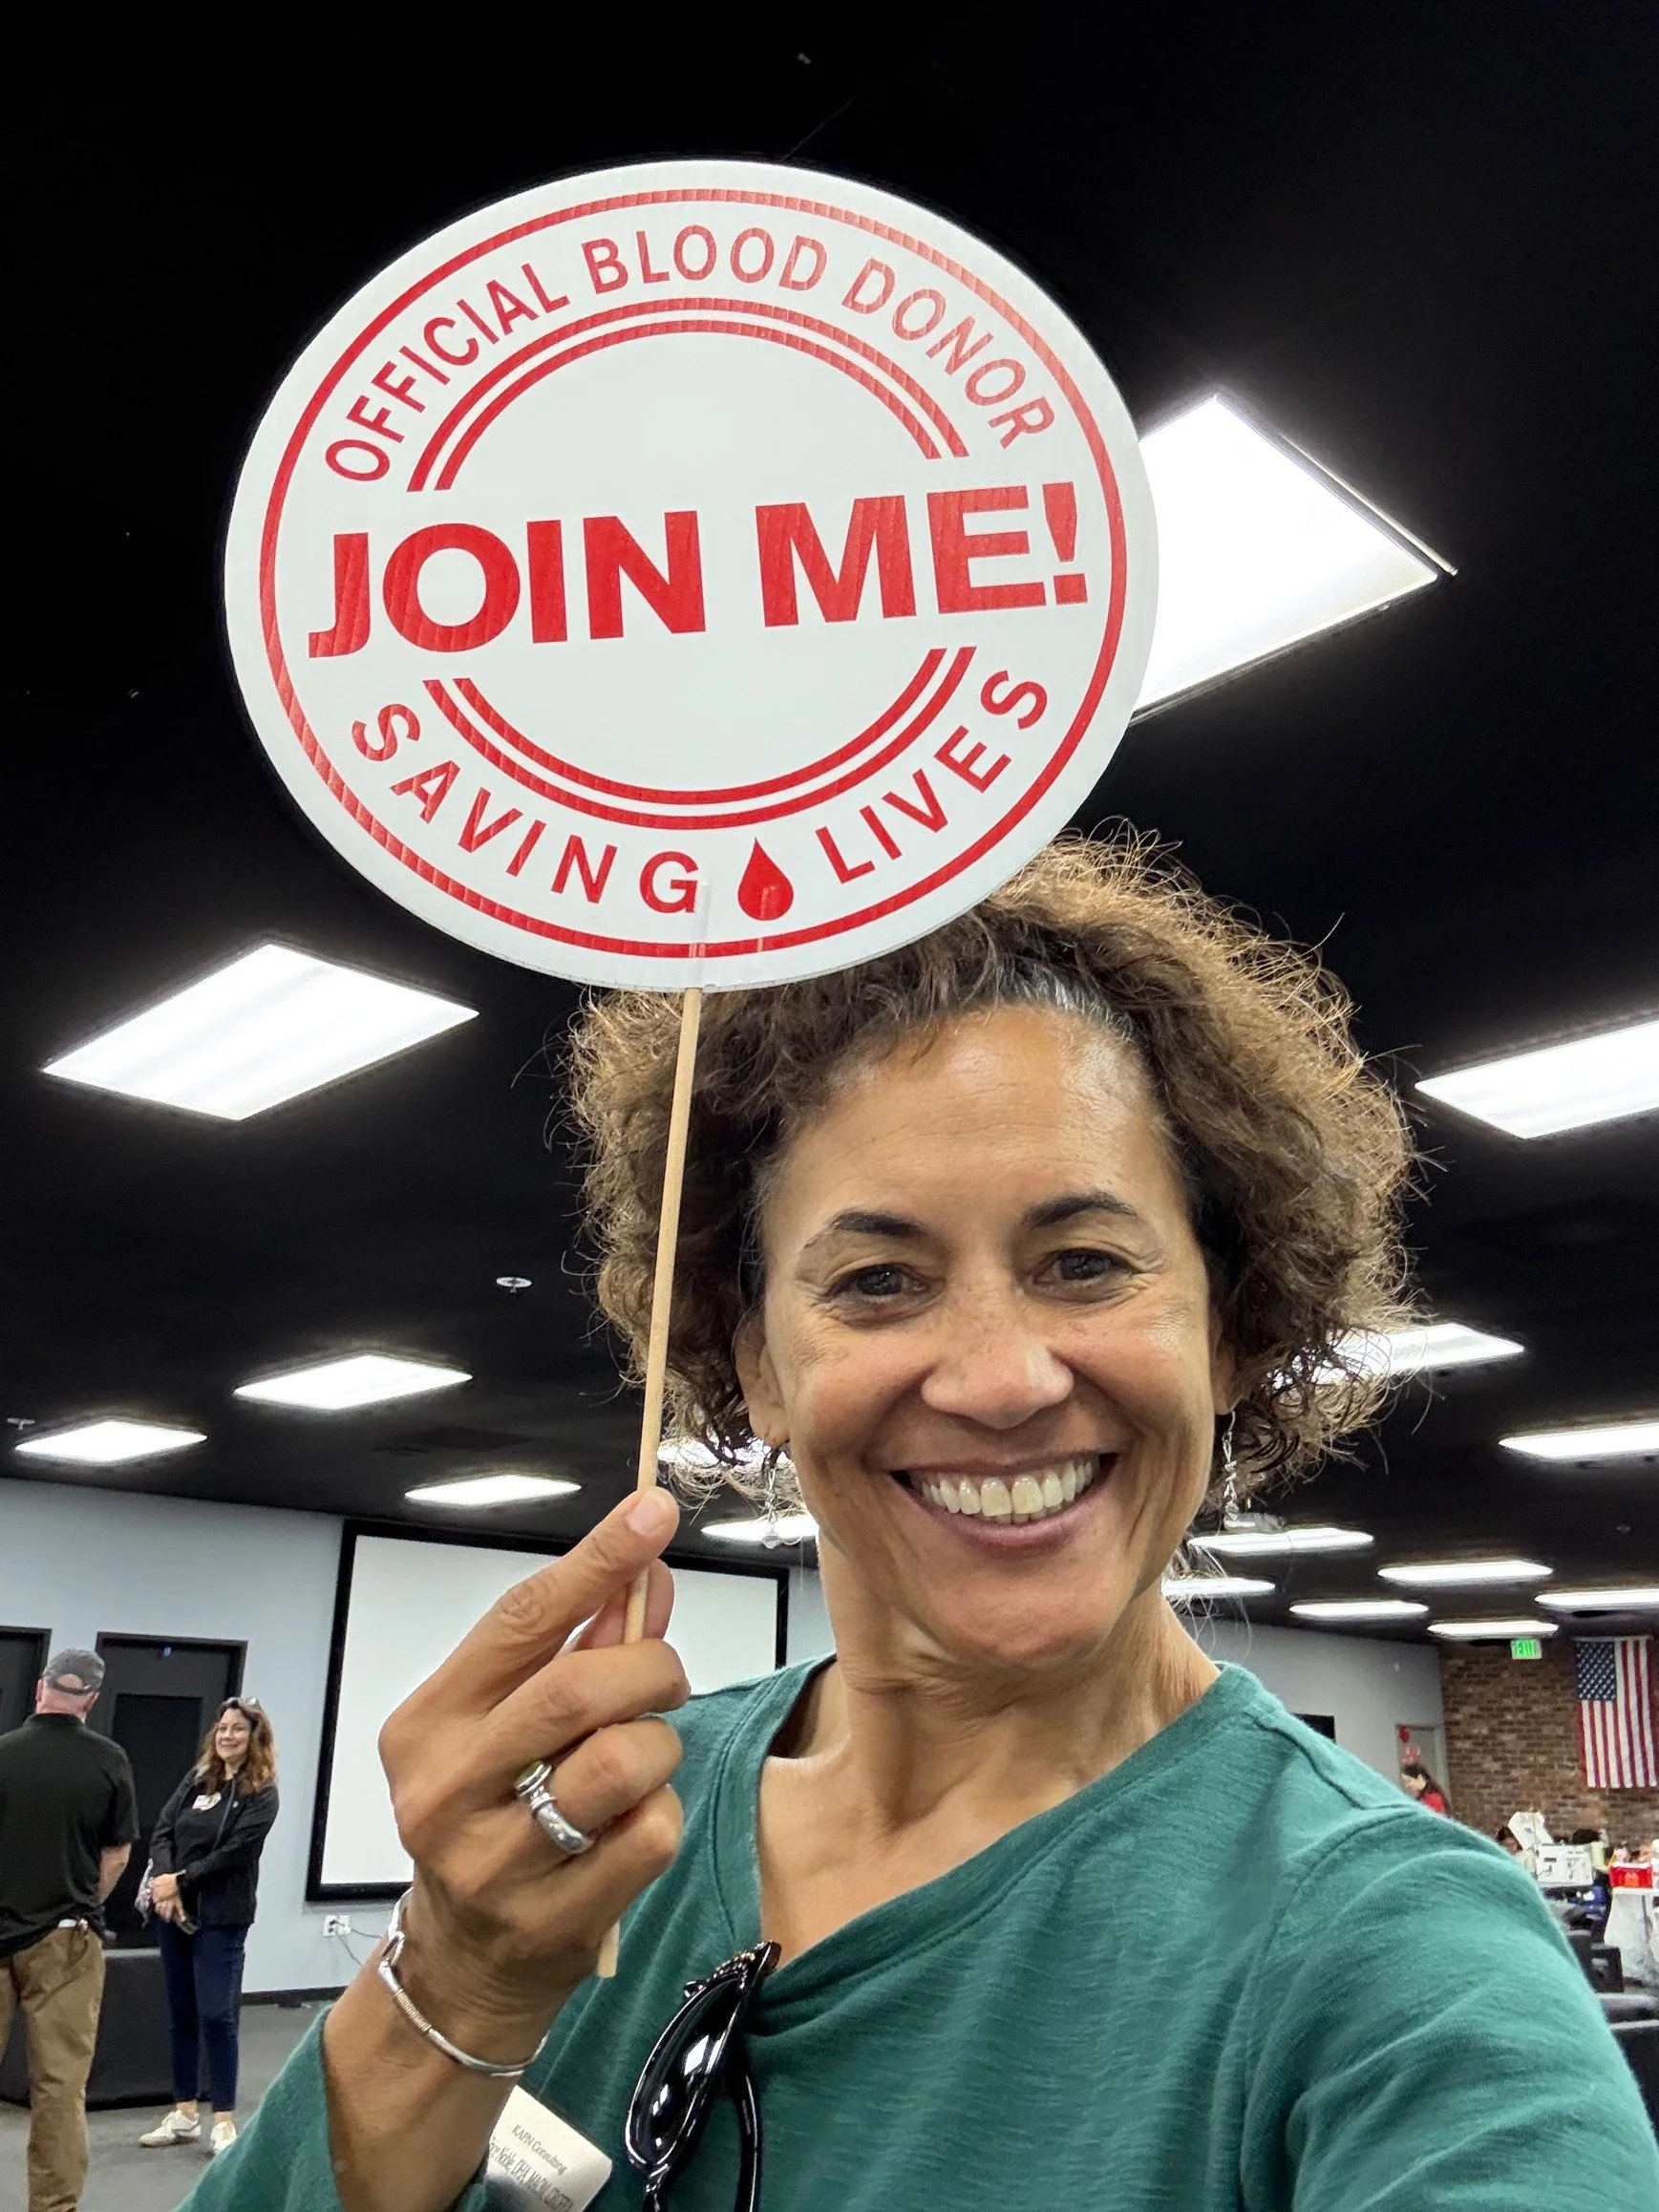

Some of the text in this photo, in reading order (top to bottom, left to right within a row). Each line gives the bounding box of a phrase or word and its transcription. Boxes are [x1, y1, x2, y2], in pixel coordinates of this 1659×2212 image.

[325, 225, 1054, 482] OFFICIAL BLOOD DONOR
[308, 480, 1089, 659] JOIN ME!
[351, 670, 1049, 915] SAVING LIVES
[531, 2140, 568, 2176] Consulting
